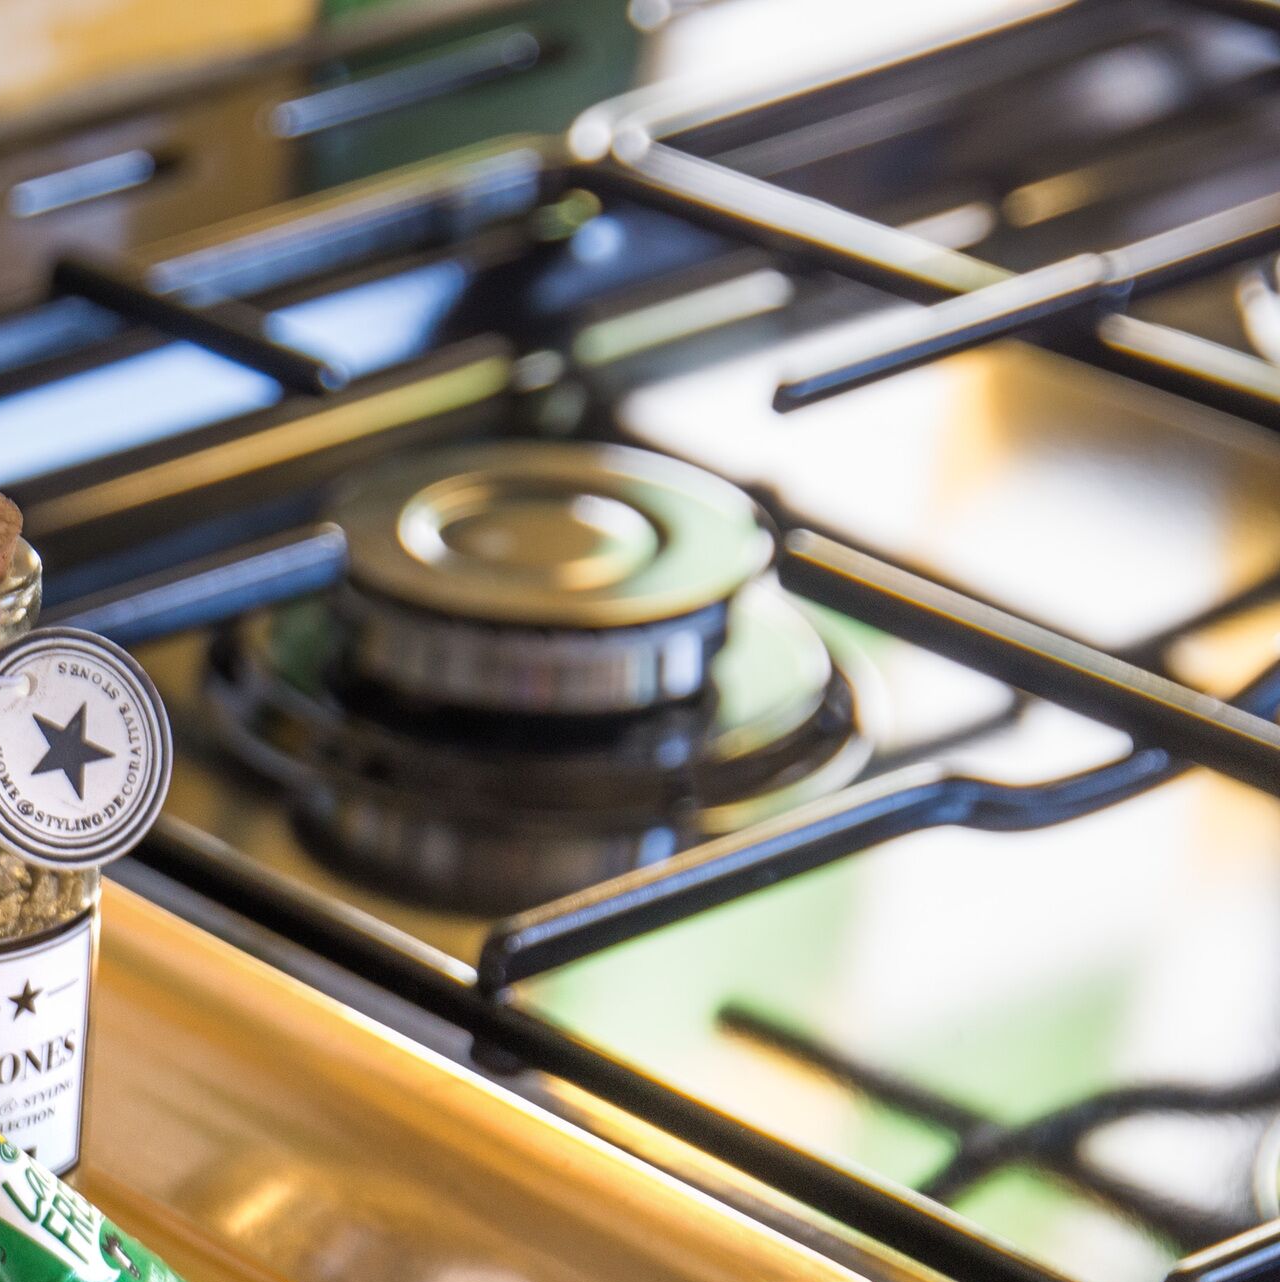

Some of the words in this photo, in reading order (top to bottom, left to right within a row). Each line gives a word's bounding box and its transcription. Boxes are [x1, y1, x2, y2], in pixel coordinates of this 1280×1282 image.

[57, 661, 120, 700] STONES
[105, 702, 142, 820] DECORATIVE
[34, 811, 103, 832] STYLING
[23, 1078, 73, 1108] STYLING
